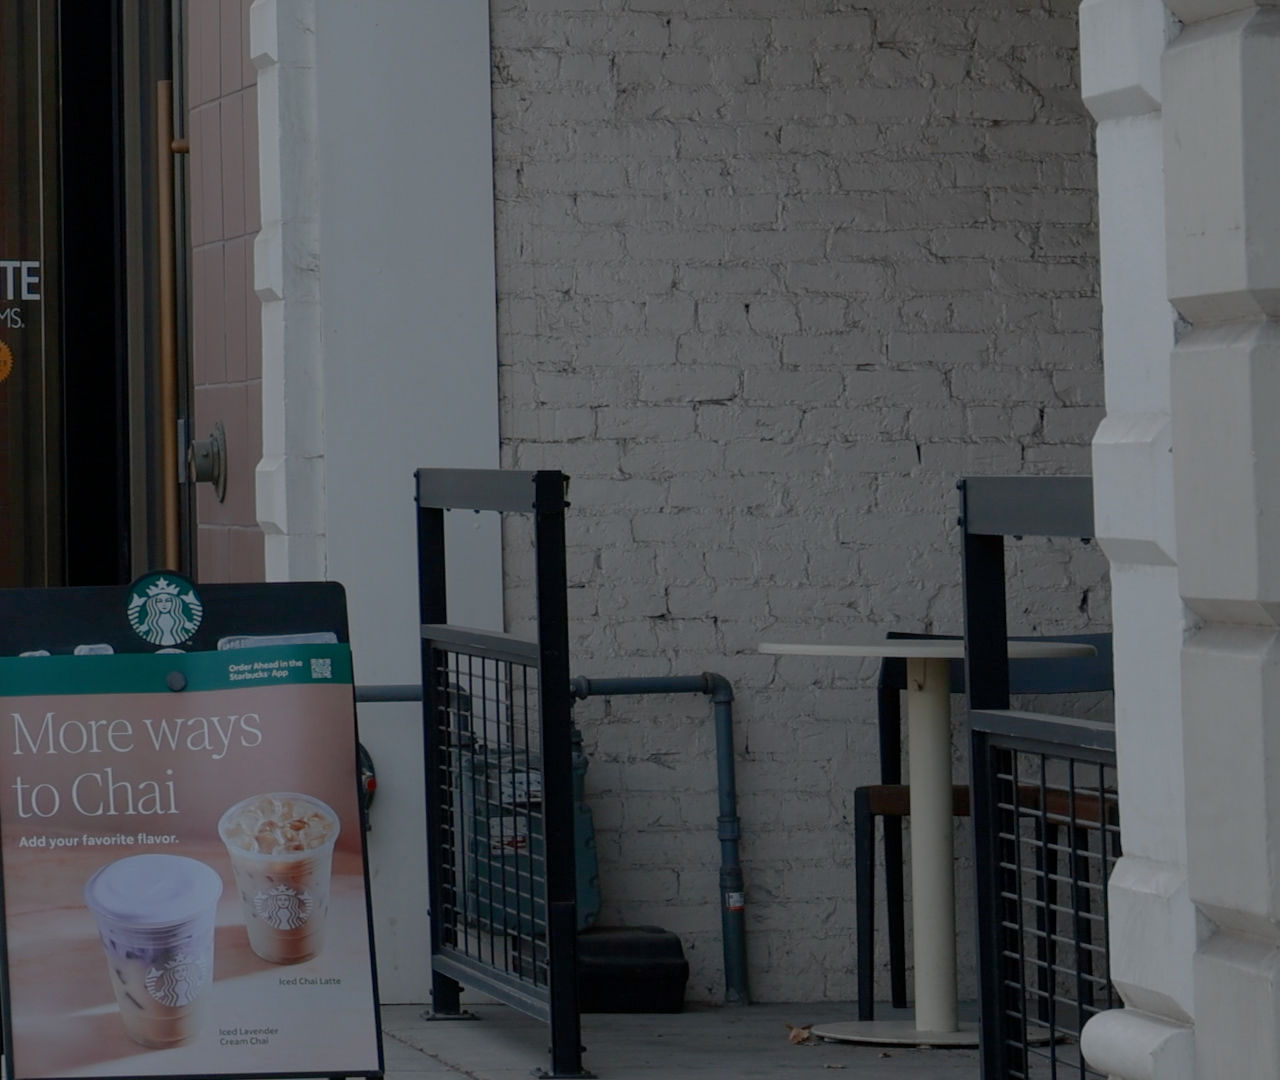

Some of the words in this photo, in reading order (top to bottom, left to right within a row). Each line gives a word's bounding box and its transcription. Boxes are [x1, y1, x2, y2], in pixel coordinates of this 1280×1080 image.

[229, 663, 251, 672] Order
[253, 661, 278, 670] Ahead
[280, 660, 288, 668] in
[289, 659, 303, 667] the
[272, 669, 289, 678] App
[10, 712, 134, 755] More
[142, 713, 262, 760] ways
[11, 776, 60, 818] to
[72, 767, 180, 816] Chai
[19, 835, 46, 848] Add
[49, 837, 78, 849] your
[82, 834, 135, 846] favorite
[137, 832, 180, 845] flavor.
[278, 977, 298, 986] Iced
[298, 977, 318, 986] Chai
[319, 977, 342, 986] Latte
[219, 1028, 238, 1036] Iced
[239, 1027, 279, 1036] Lavender
[219, 1038, 248, 1046] Cream
[250, 1037, 269, 1045] Chai
